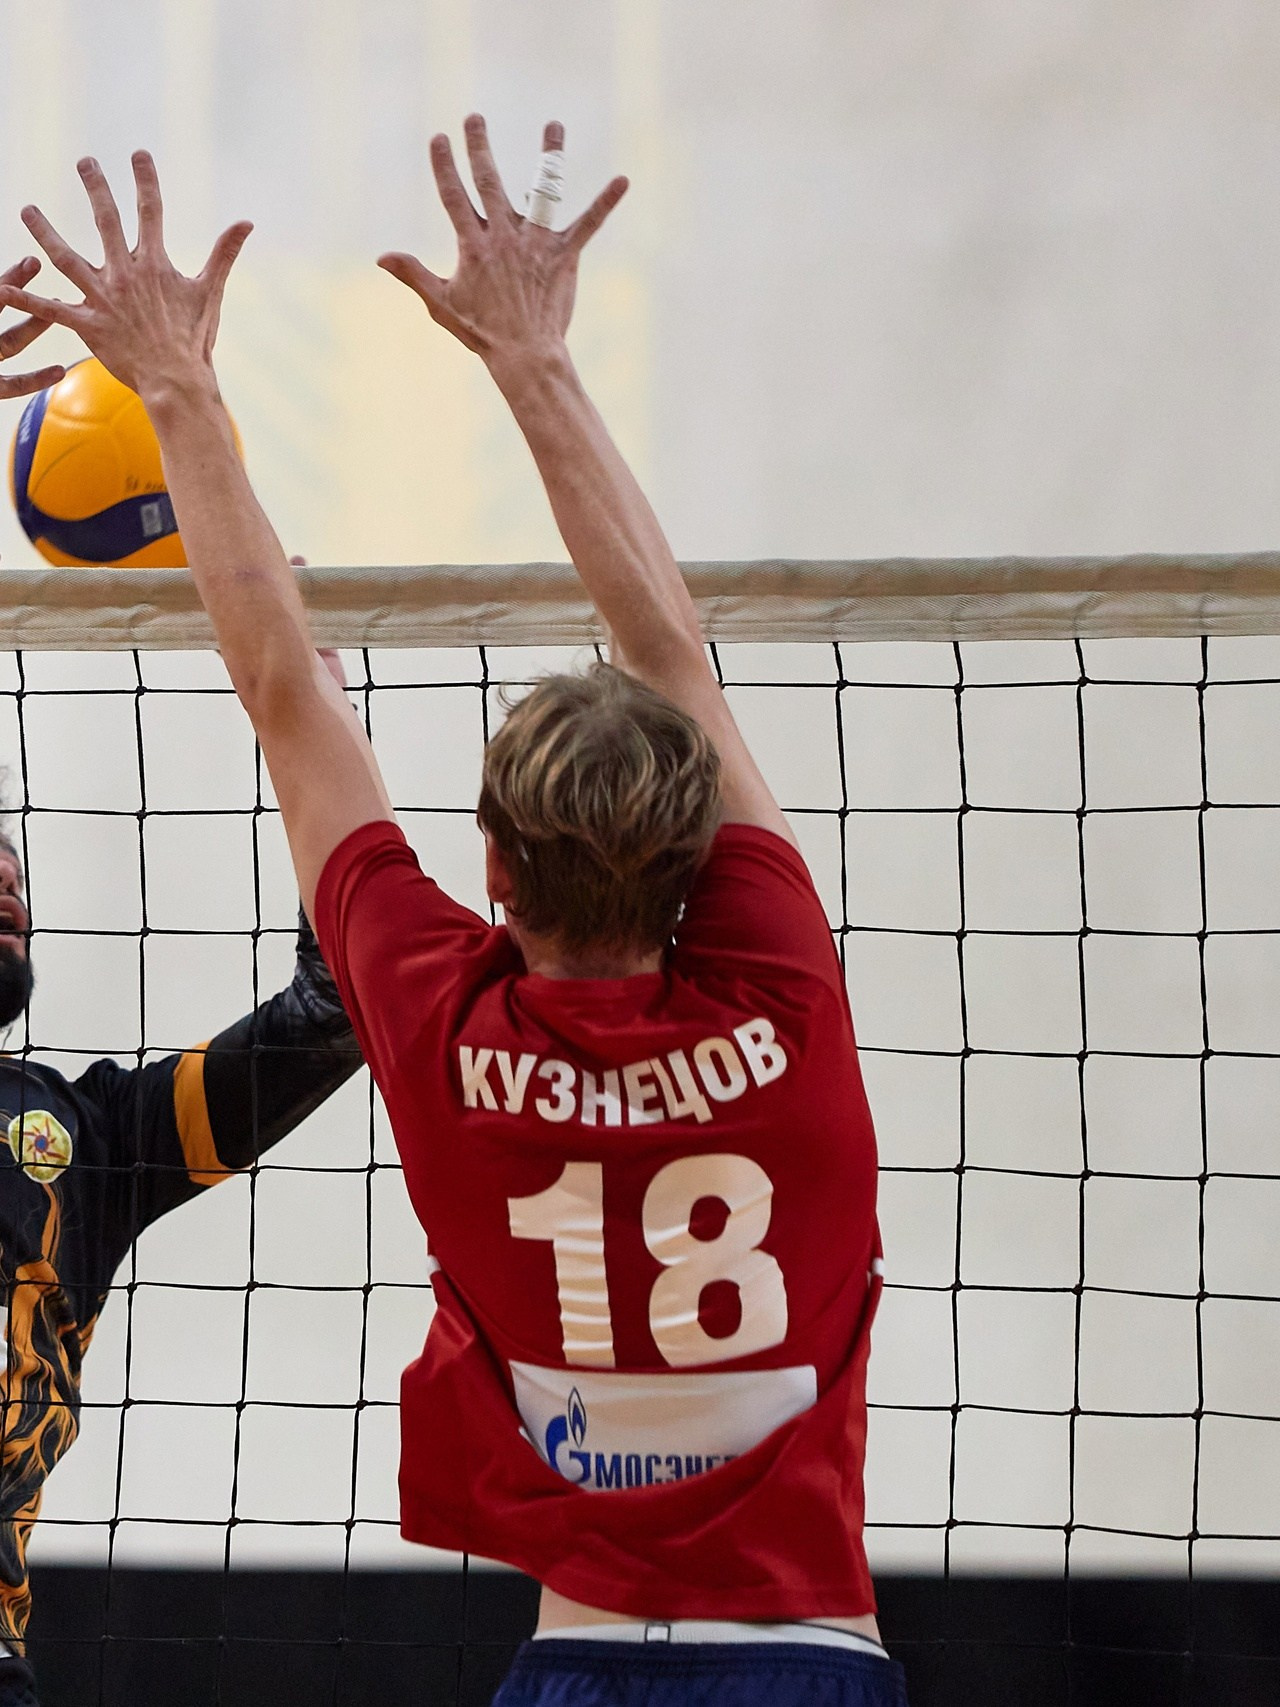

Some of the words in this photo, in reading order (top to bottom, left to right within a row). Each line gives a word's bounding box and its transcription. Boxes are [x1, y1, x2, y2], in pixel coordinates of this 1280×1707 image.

[458, 1017, 788, 1127] КУЗНЕЦОВ
[507, 1153, 789, 1368] 18
[594, 1452, 740, 1489] МОСЭН
